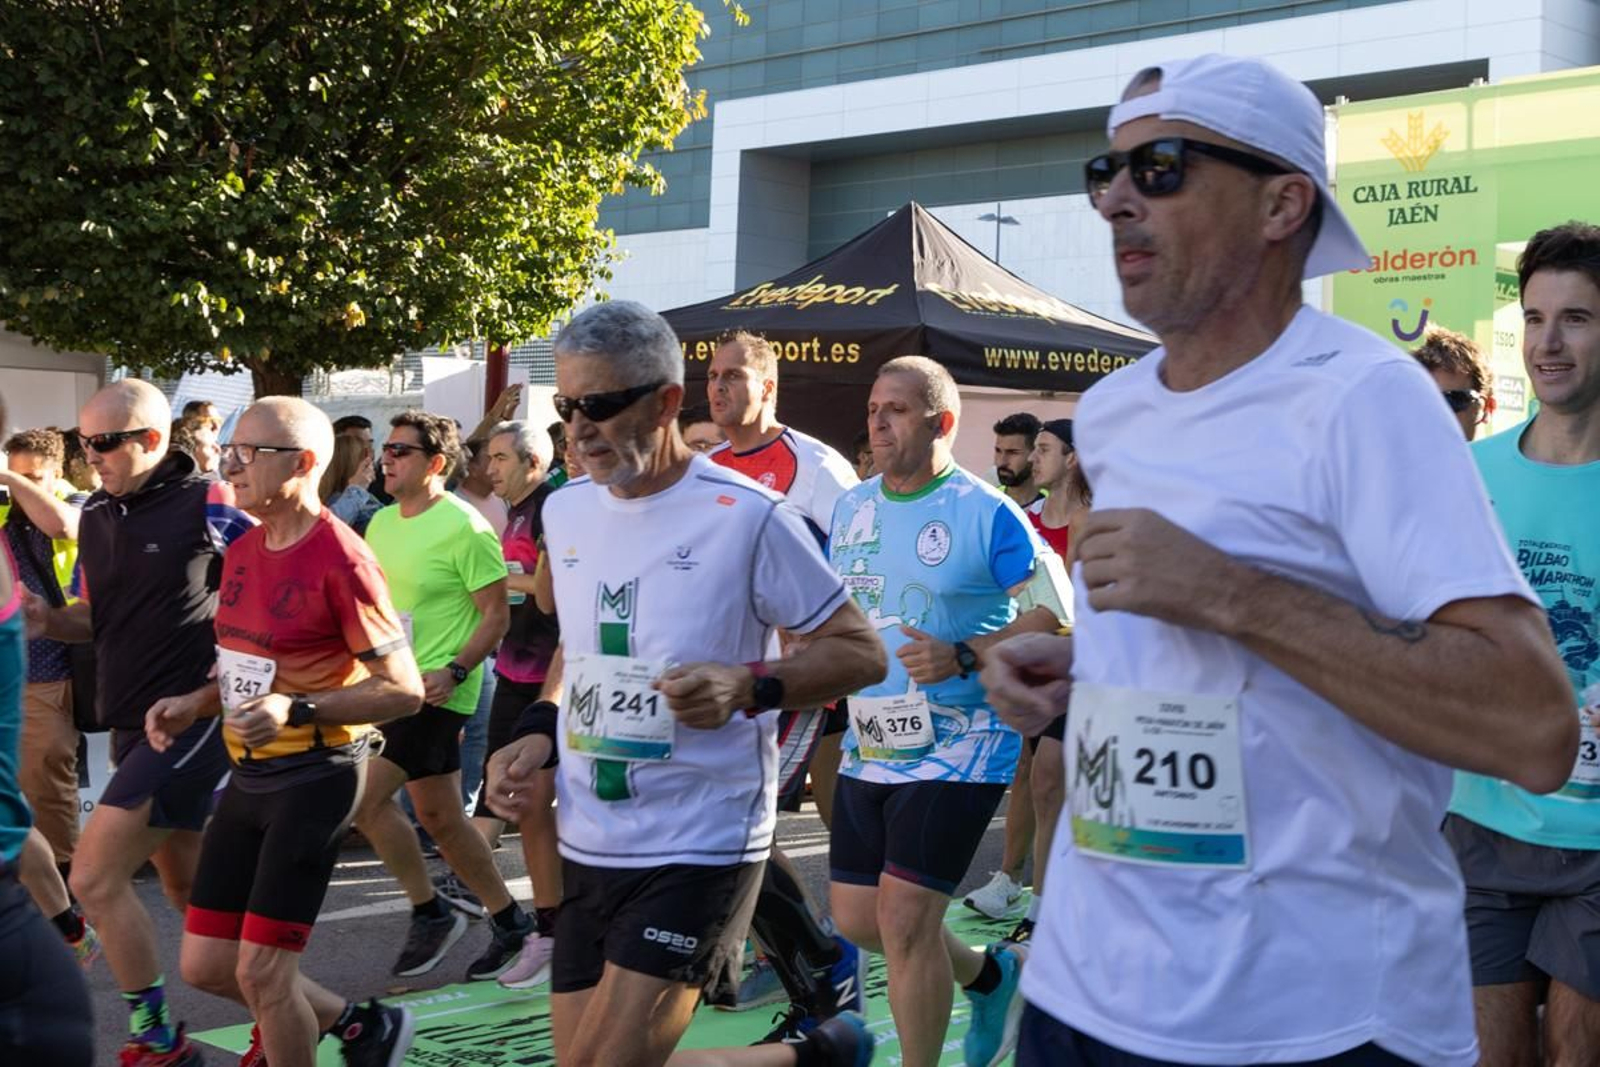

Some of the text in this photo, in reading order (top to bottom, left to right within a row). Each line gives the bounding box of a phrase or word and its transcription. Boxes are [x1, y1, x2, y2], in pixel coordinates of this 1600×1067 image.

[1353, 175, 1478, 204] CAJA RURAL
[1387, 203, 1439, 227] JAÉN
[1373, 273, 1446, 284] obras maestras
[1517, 548, 1569, 569] BILBAO
[1529, 568, 1596, 588] MARATHON
[235, 677, 261, 695] 247
[610, 690, 660, 717] 241
[886, 716, 922, 733] 376
[1134, 748, 1217, 790] 210
